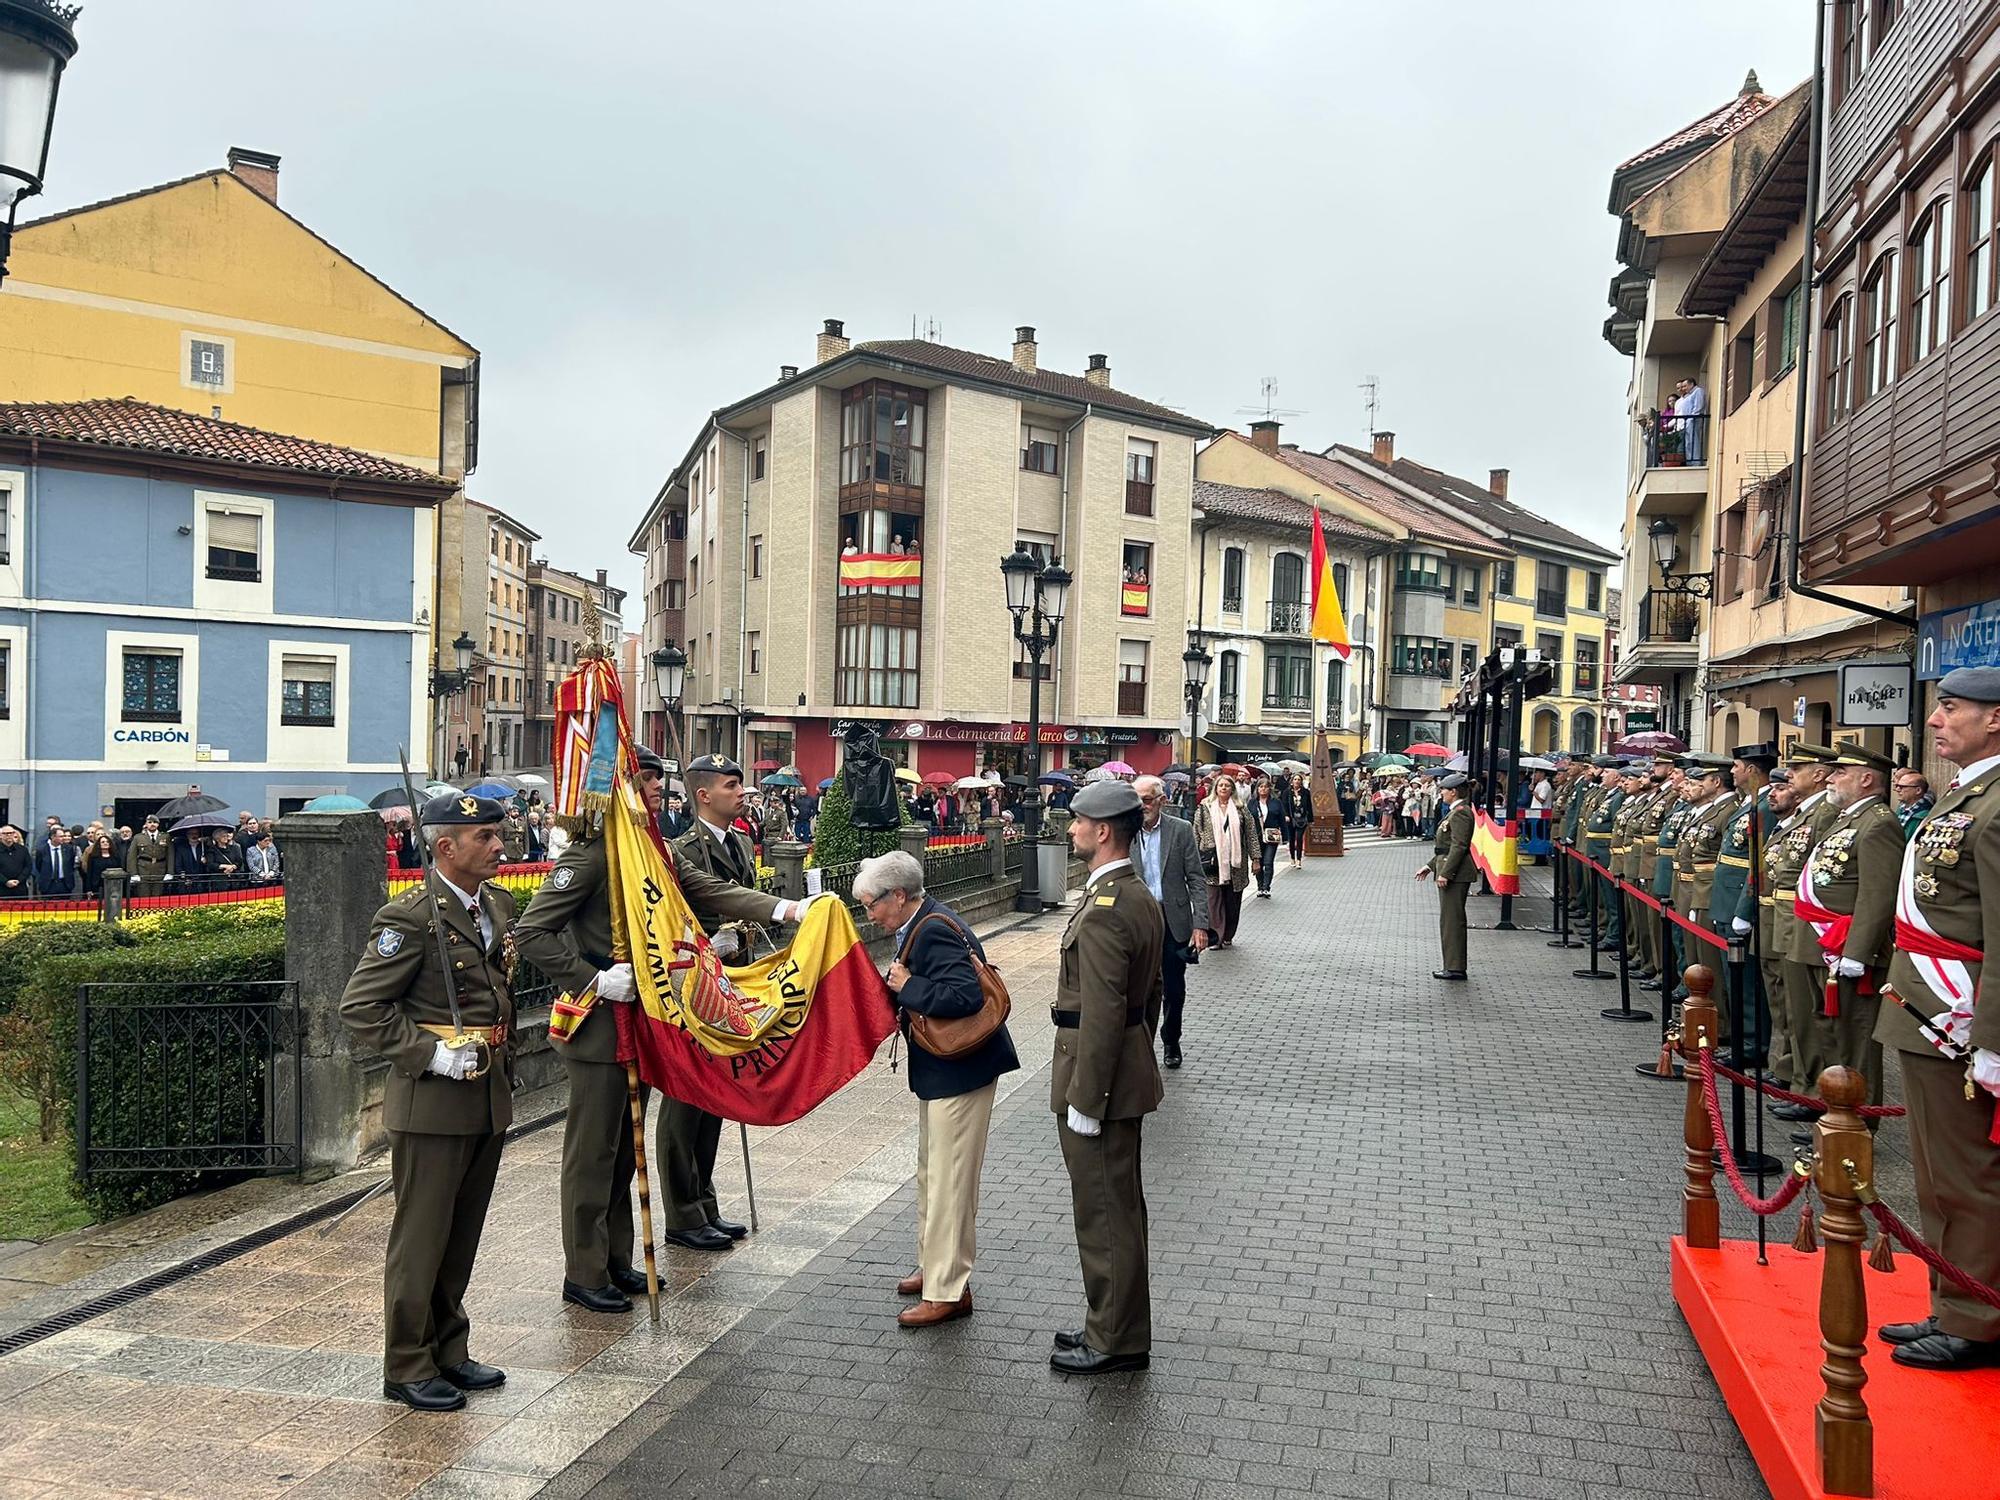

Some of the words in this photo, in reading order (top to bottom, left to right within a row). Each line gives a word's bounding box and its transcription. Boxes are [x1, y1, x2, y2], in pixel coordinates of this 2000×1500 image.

[114, 727, 190, 743] CARBÓN
[926, 725, 943, 739] La
[945, 725, 1011, 741] Carnicería
[1013, 726, 1027, 741] de
